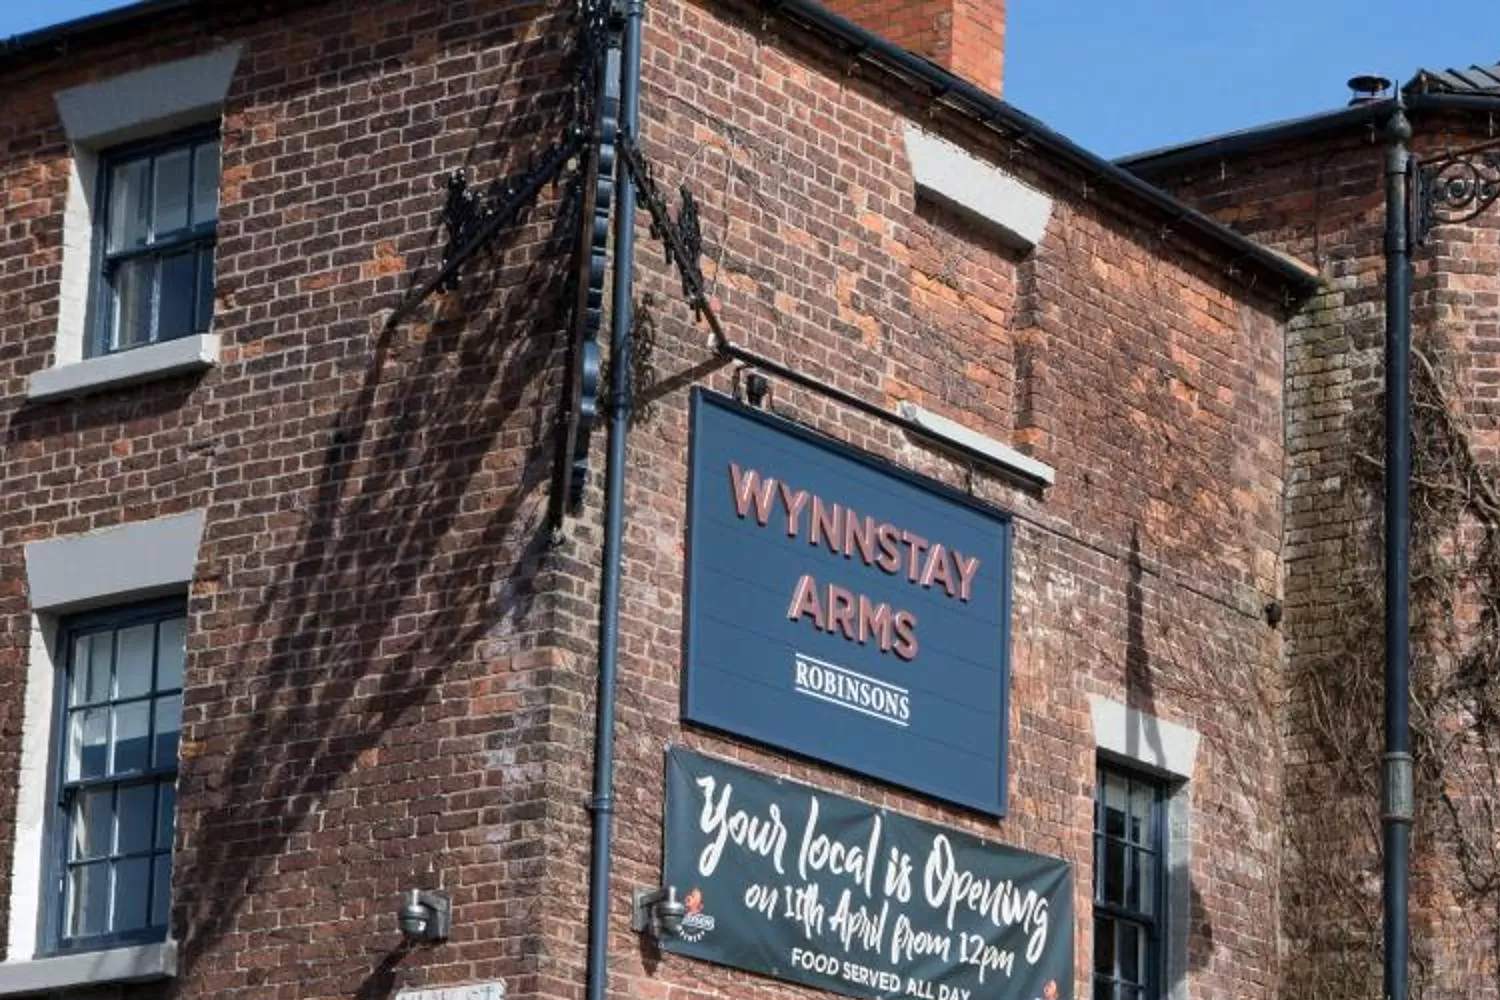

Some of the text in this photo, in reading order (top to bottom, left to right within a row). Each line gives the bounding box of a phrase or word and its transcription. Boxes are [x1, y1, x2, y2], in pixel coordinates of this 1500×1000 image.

[729, 463, 979, 602] WYNNSTAY
[786, 574, 920, 661] ARMS
[795, 659, 911, 722] ROBINSONS
[696, 775, 1050, 965] Your local is Opening
[745, 883, 778, 920] on
[828, 890, 889, 955] April
[891, 917, 952, 965] from
[960, 934, 1014, 985] 12pm
[791, 947, 839, 977] FOOD
[843, 964, 901, 993] SERVED
[905, 981, 935, 1000] ALL
